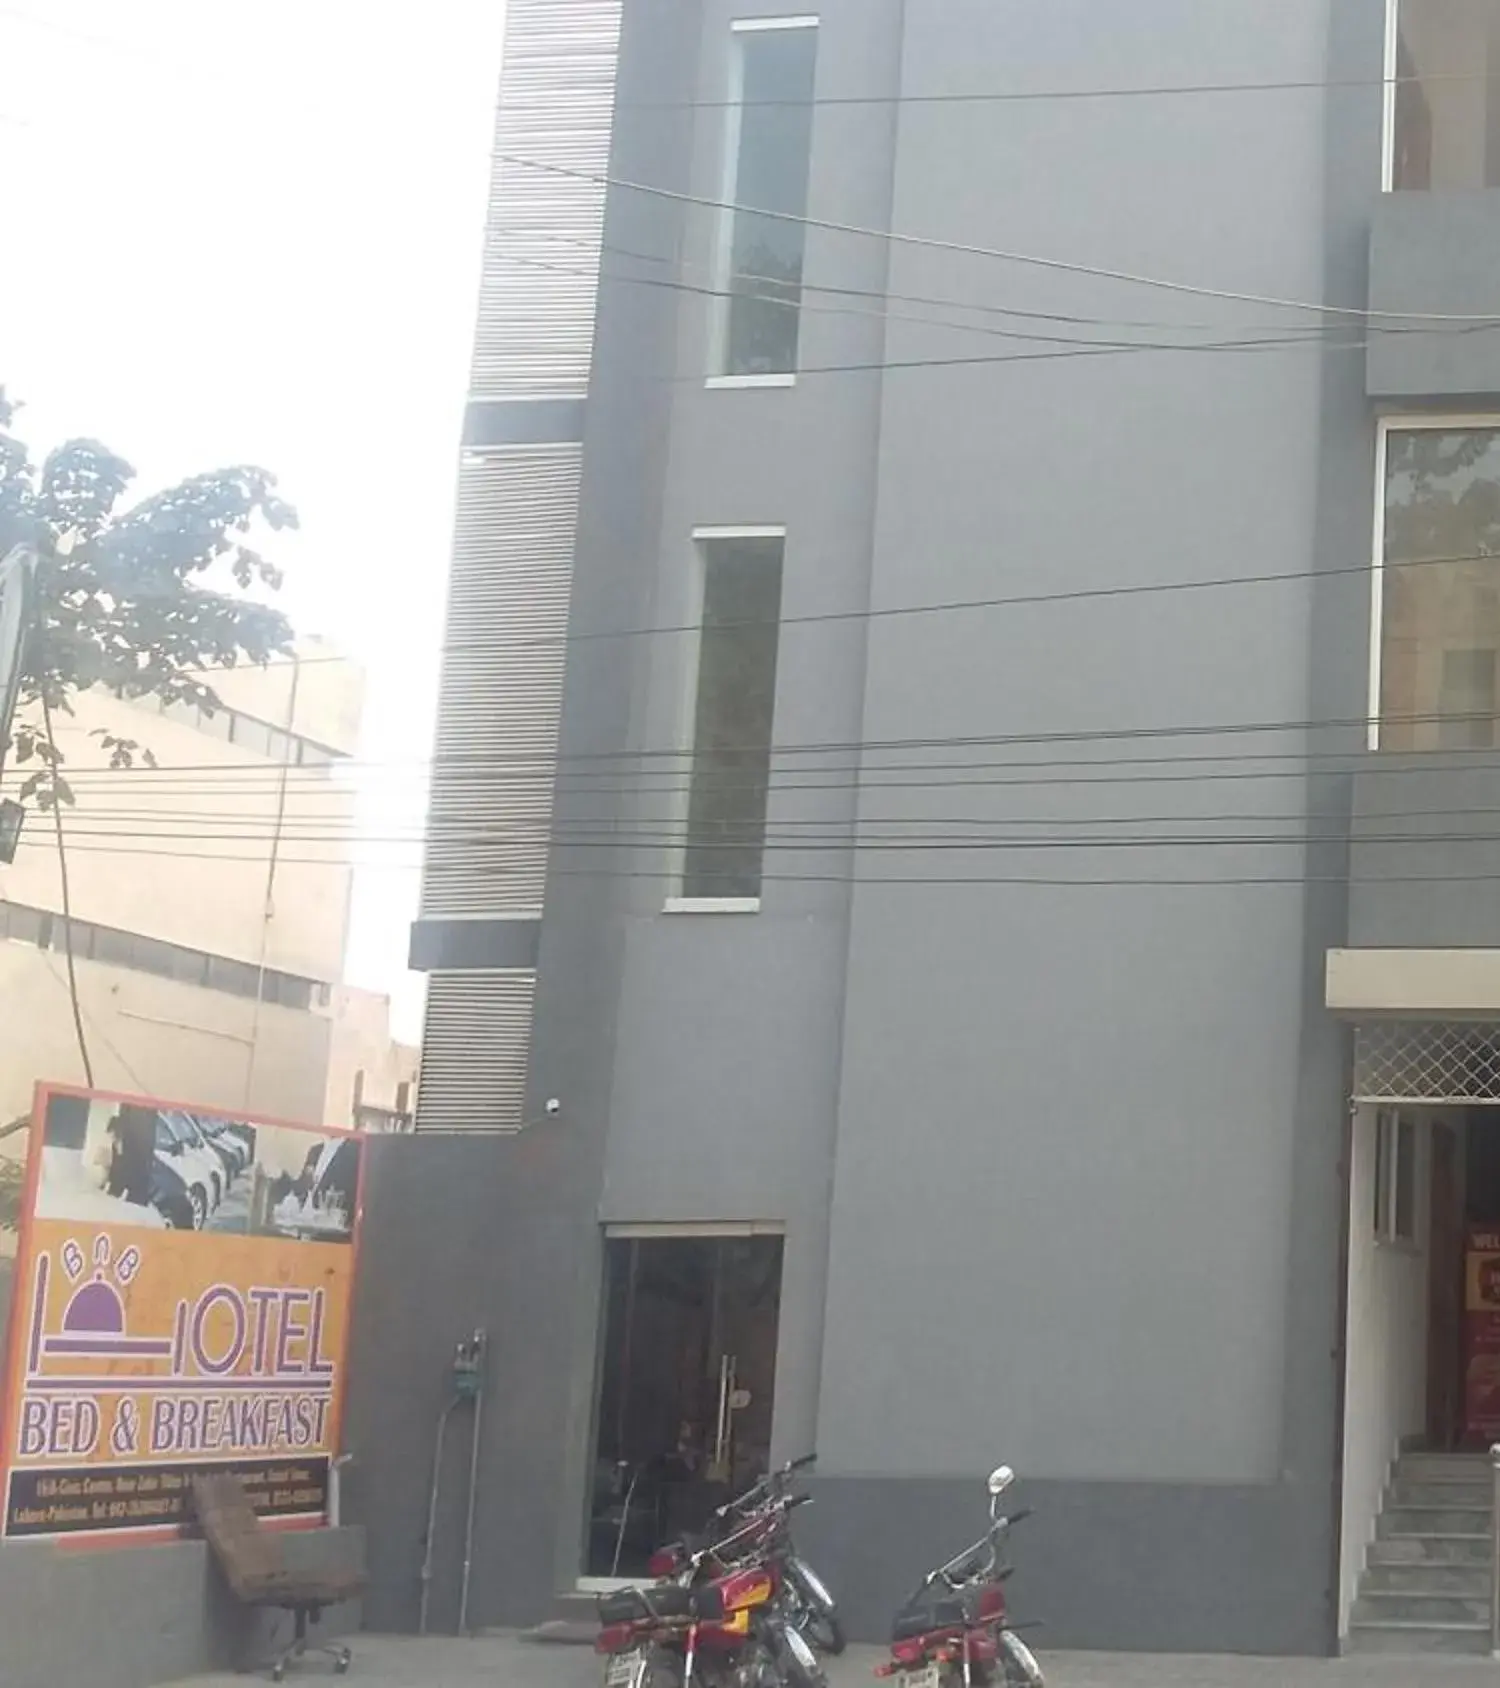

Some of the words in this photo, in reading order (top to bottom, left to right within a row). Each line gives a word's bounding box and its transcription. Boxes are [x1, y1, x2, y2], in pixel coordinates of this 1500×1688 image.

[20, 1398, 99, 1455] BED
[111, 1398, 139, 1454] &
[151, 1394, 330, 1452] BREAKFAST
